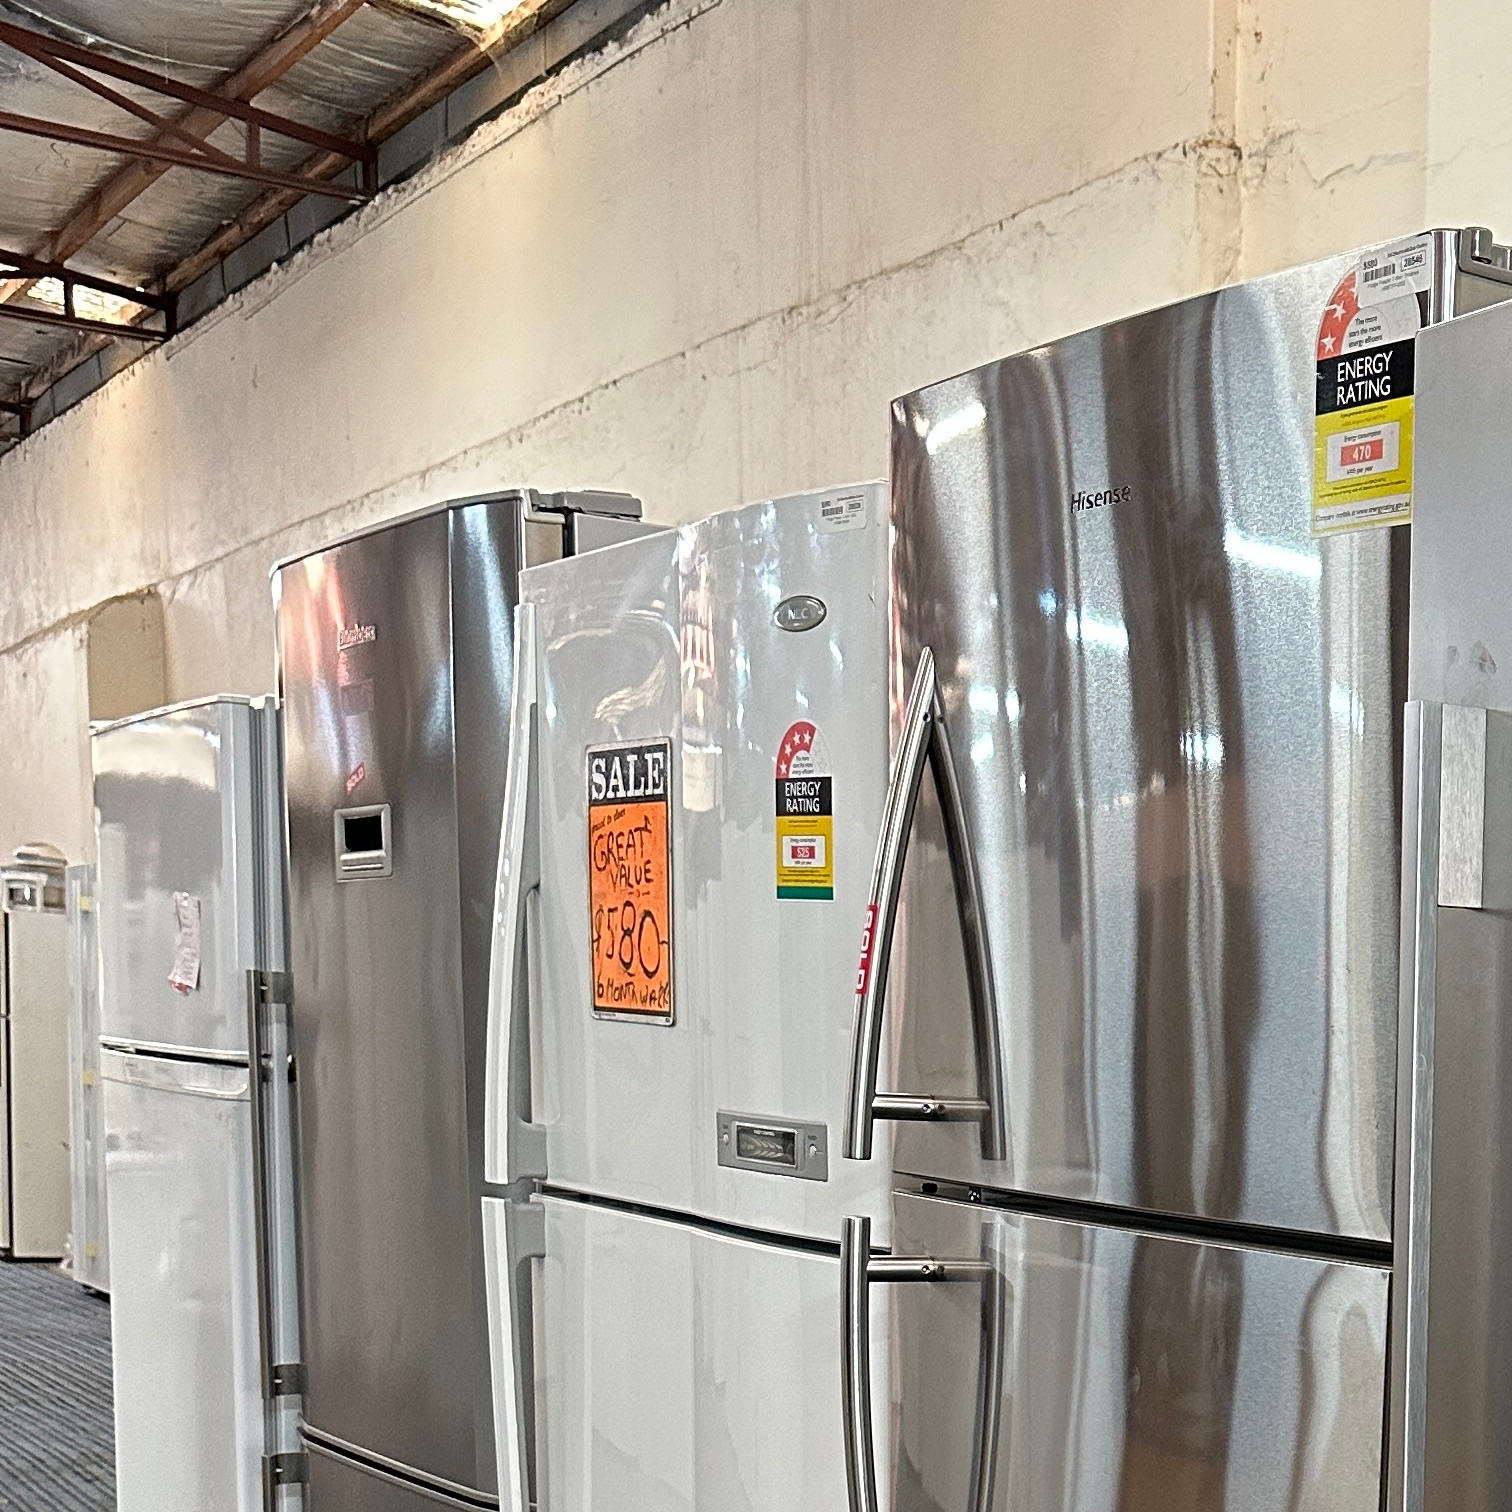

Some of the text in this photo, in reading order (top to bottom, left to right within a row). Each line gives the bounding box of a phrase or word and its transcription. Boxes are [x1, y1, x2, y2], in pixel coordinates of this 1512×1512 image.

[1337, 350, 1394, 382] ENERGY
[1336, 375, 1391, 406] RATING
[1353, 444, 1371, 461] 470
[1070, 485, 1132, 513] Hisense
[592, 752, 664, 800] SALE
[785, 781, 821, 796] ENERGY
[786, 797, 820, 813] RATING
[593, 815, 652, 872] GREAT
[609, 859, 654, 893] VALUE
[594, 900, 660, 979] $580
